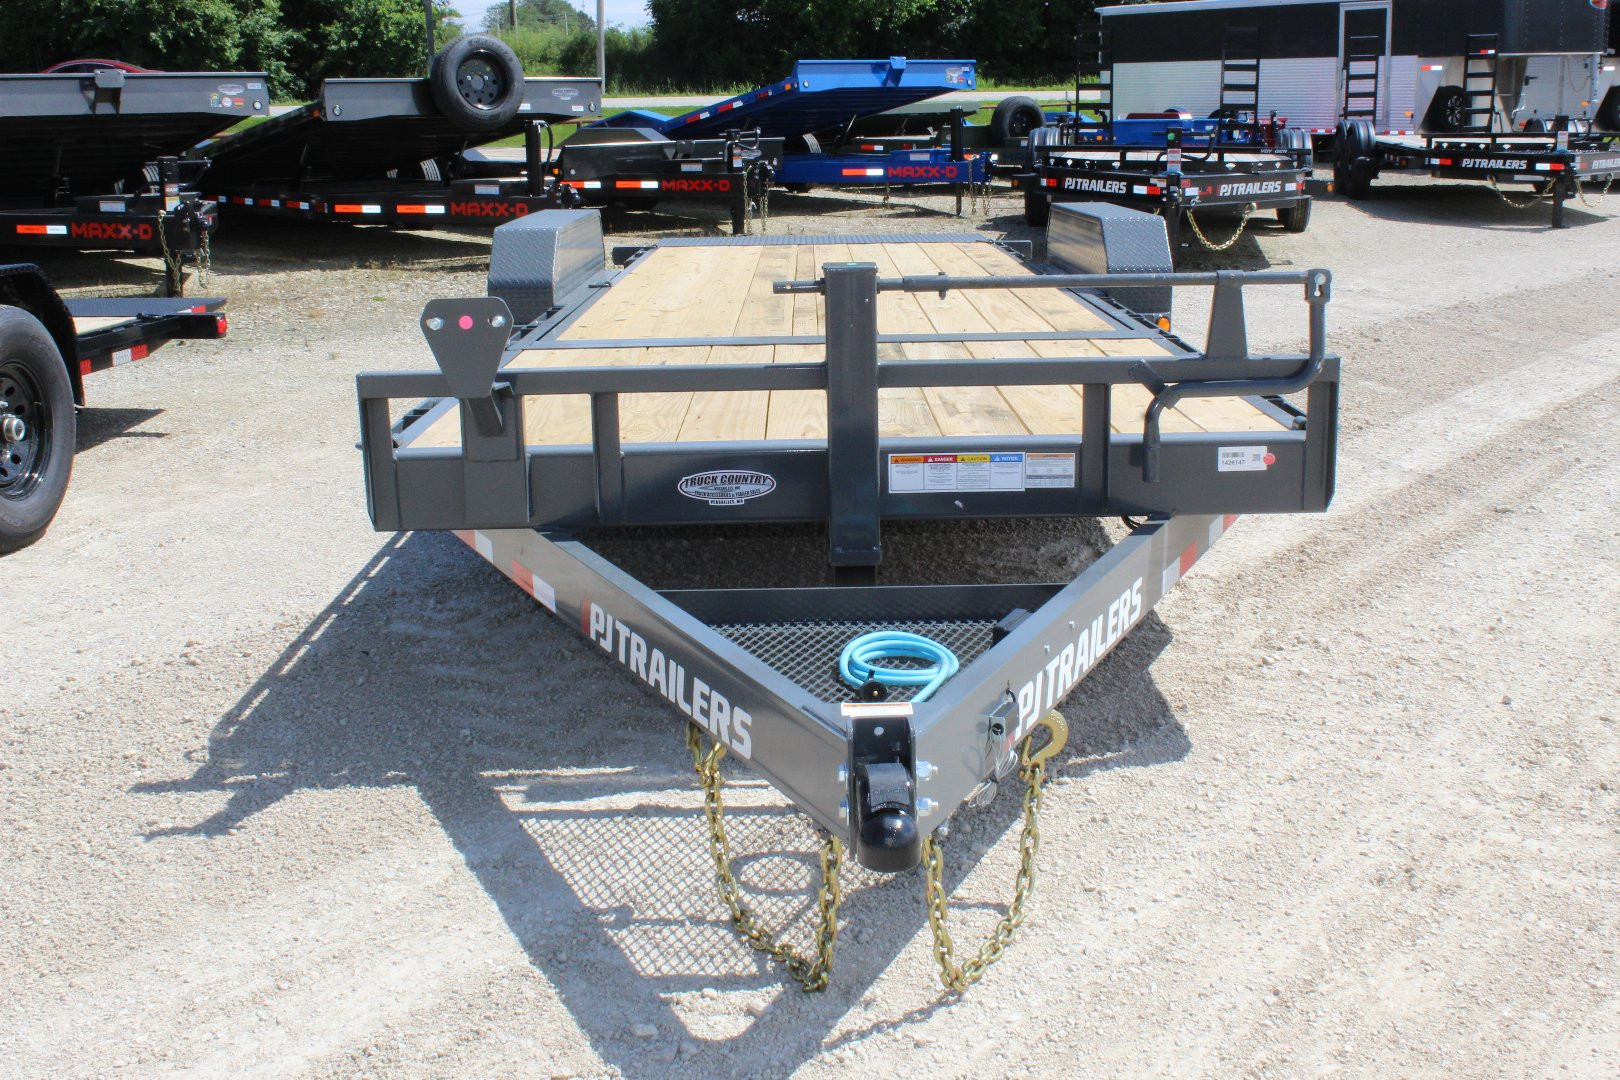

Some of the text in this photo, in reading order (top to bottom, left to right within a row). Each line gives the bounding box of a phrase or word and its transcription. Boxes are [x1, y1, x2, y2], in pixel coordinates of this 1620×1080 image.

[887, 165, 957, 178] MAXX-D
[662, 179, 731, 192] MAXX-D
[451, 201, 529, 217] MAXX-D
[71, 222, 153, 240] MAXX-D
[684, 474, 769, 488] TRUCK COUNTRY
